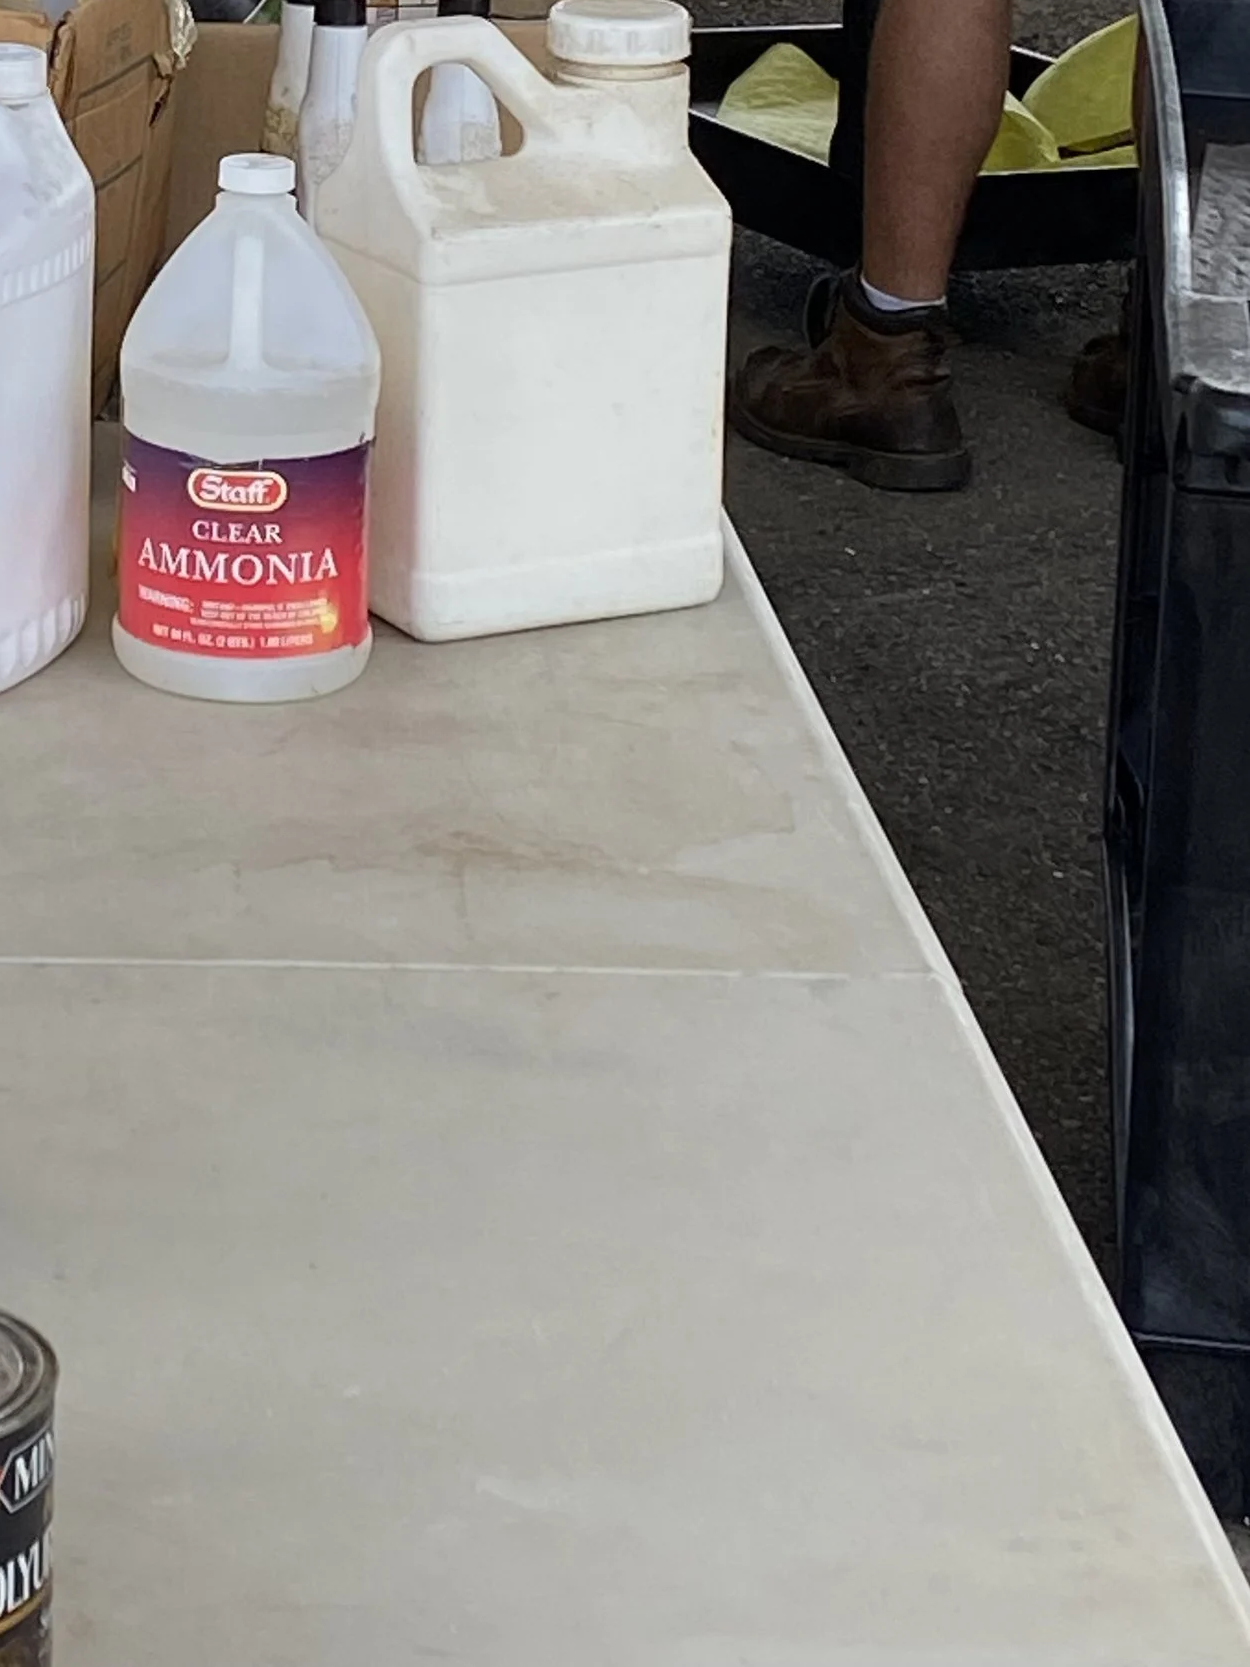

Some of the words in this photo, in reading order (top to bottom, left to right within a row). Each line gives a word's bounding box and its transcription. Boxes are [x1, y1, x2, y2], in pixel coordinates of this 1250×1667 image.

[199, 476, 274, 504] Staff
[192, 520, 283, 544] CLEAR
[138, 537, 338, 585] AMMONIA
